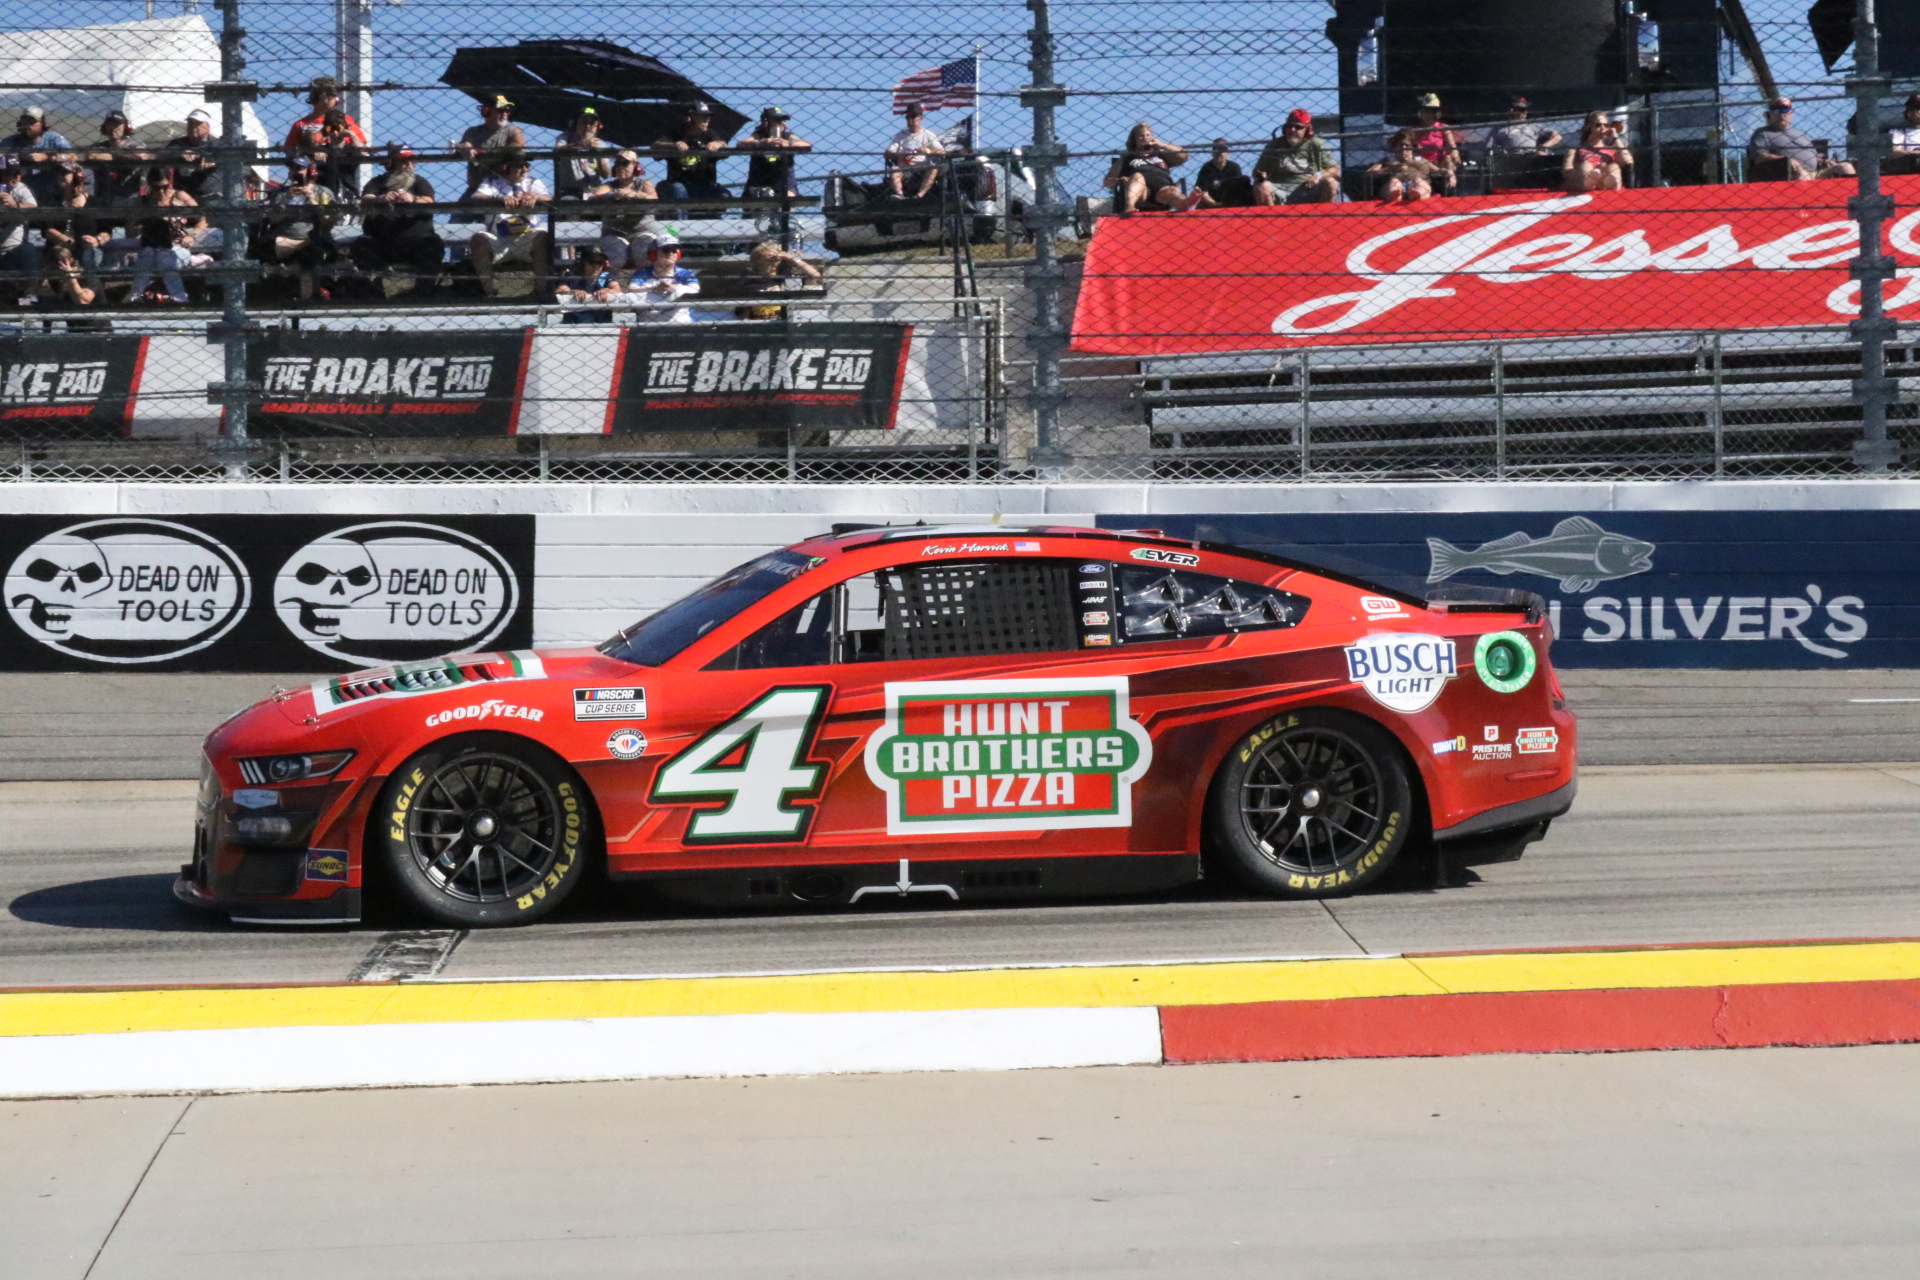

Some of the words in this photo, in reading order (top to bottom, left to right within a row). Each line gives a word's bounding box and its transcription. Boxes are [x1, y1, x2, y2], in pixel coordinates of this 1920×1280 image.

[1272, 194, 1861, 338] Jesse
[56, 368, 107, 394] PAD
[263, 364, 311, 391] THE
[310, 357, 446, 398] BRAKE
[444, 363, 493, 391] PAD
[646, 359, 694, 386] THE
[693, 348, 826, 393] BRAKE
[822, 356, 872, 383] PAD
[921, 545, 957, 556] Kevin
[958, 543, 1011, 553] Harvick
[1131, 548, 1198, 566] 4EVER
[118, 565, 180, 592] DEAD
[187, 565, 220, 592] ON
[387, 568, 447, 596] DEAD
[454, 568, 487, 594] ON
[118, 599, 217, 623] TOOLS
[385, 599, 487, 626] TOOLS
[1583, 584, 1868, 659] SILVER'S
[1347, 643, 1454, 679] BUSCH
[596, 690, 635, 700] NASCAR
[1377, 677, 1434, 694] LIGHT
[585, 704, 604, 713] CUP
[604, 703, 637, 713] SERIES
[943, 701, 1070, 736] HUNT
[1239, 715, 1300, 763] EAGLE
[1472, 743, 1512, 754] PRISTINE
[654, 688, 820, 837] 4
[892, 736, 1124, 773] BROTHERS
[1472, 752, 1512, 761] AUCTION
[390, 767, 426, 842] EAGLE
[942, 772, 1075, 809] PIZZA
